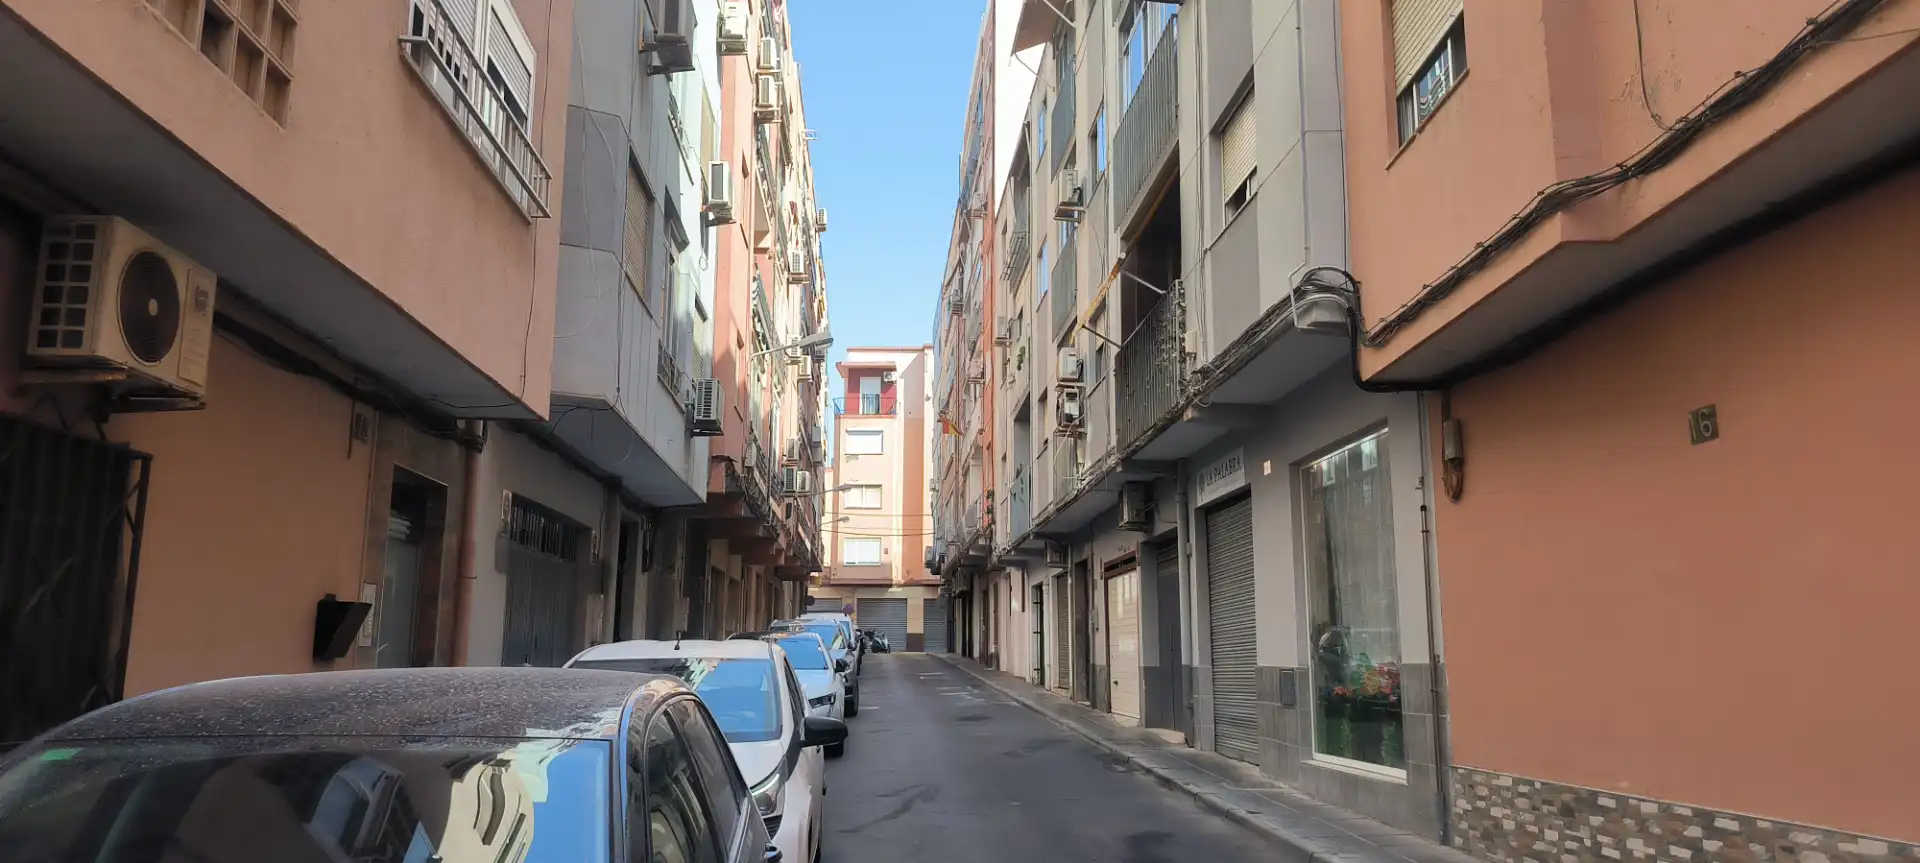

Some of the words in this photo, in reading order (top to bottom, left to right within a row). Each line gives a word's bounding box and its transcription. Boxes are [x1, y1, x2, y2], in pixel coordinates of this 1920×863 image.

[1689, 409, 1712, 440] 16
[1206, 469, 1214, 487] LA
[1214, 454, 1242, 482] PALABRA
